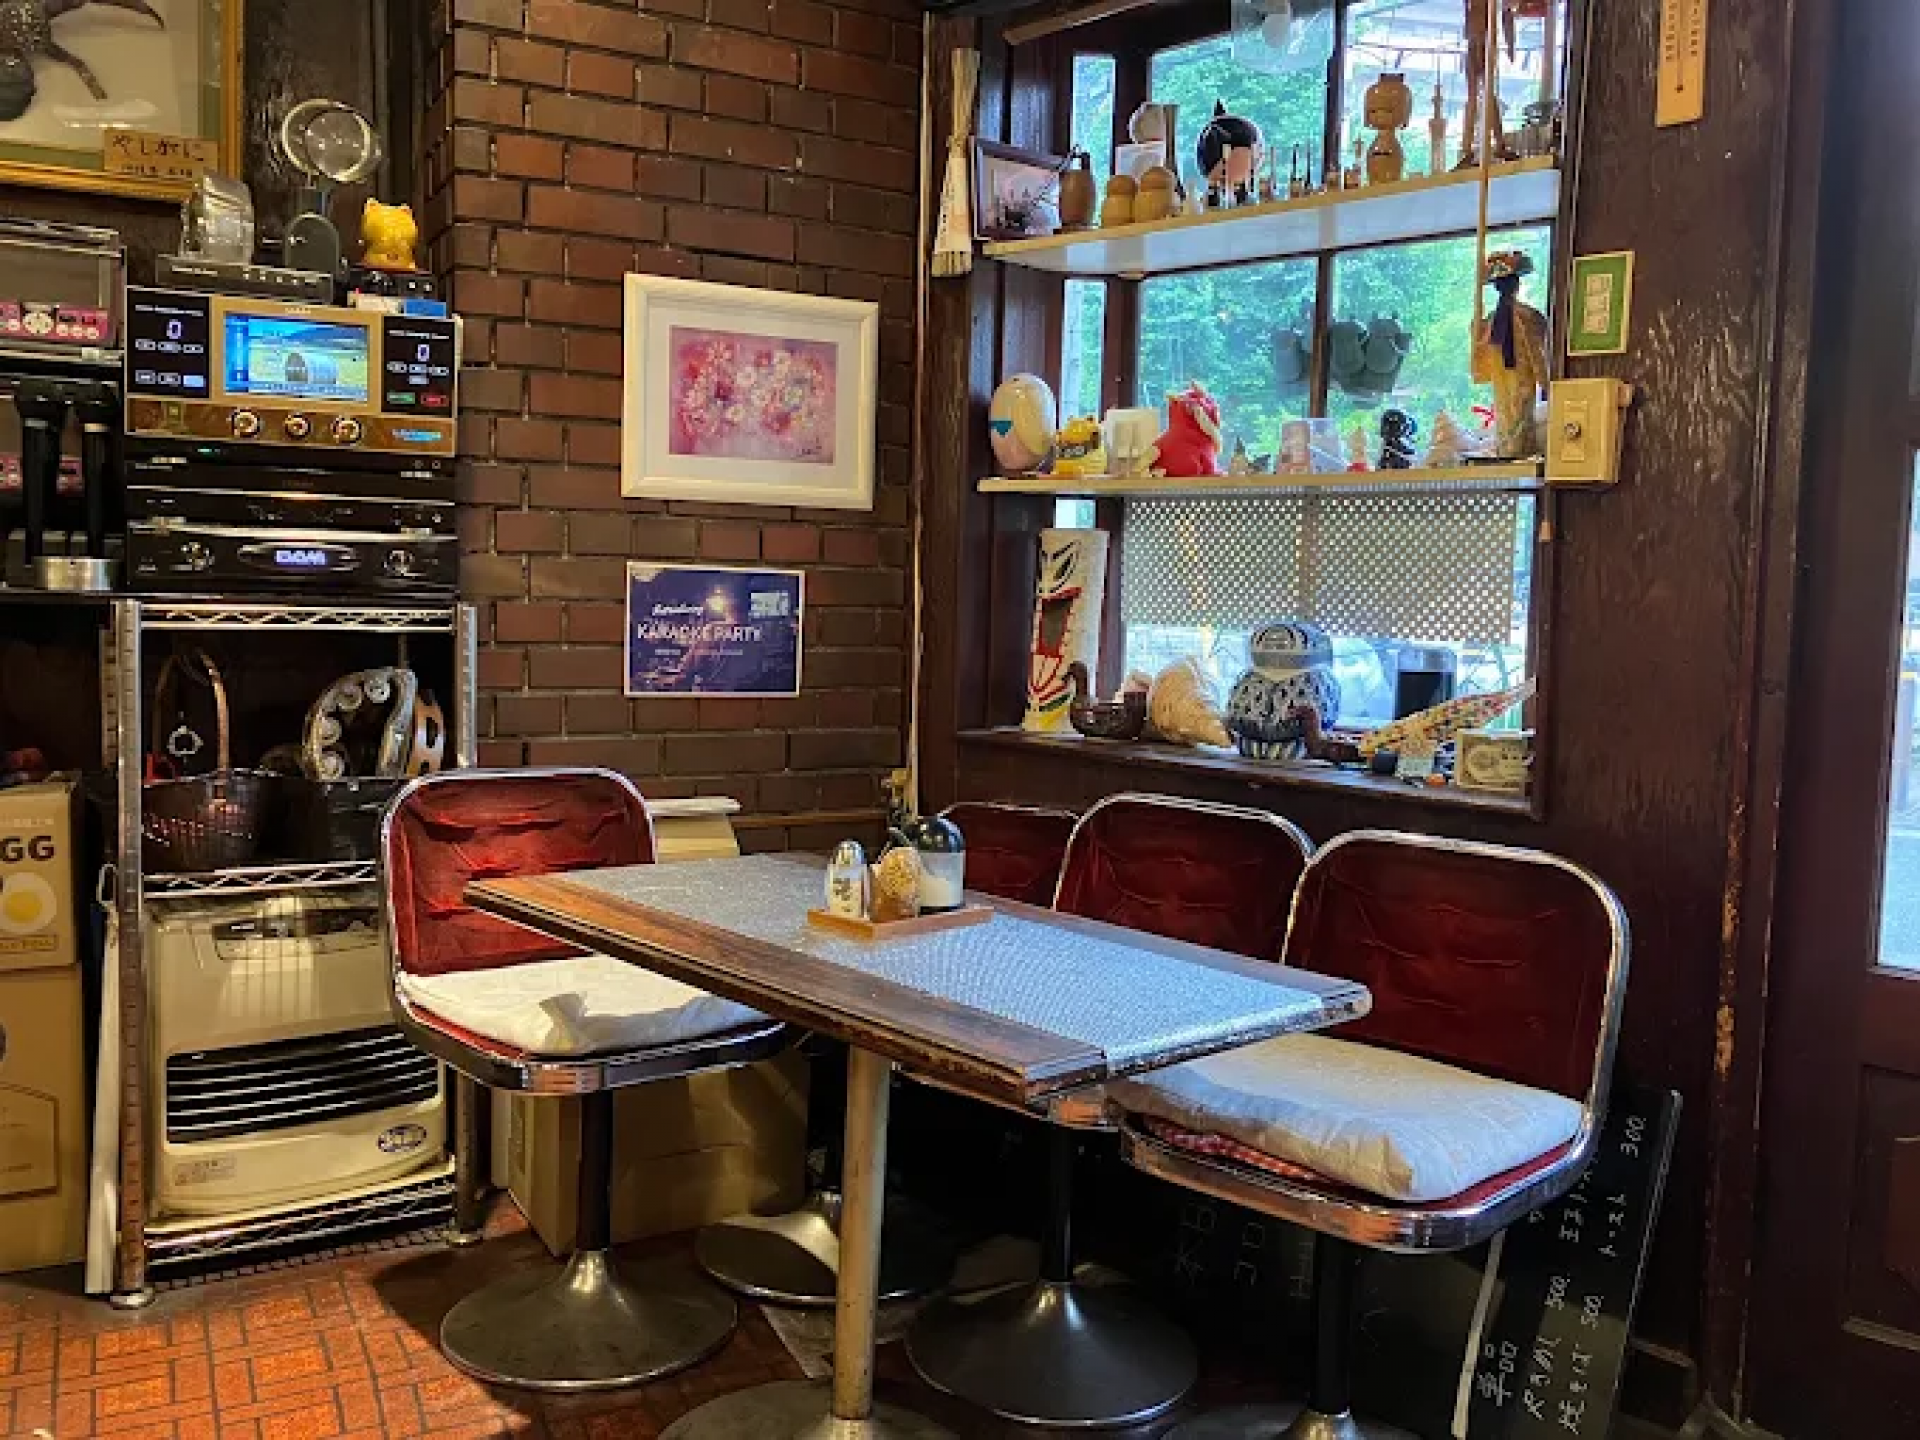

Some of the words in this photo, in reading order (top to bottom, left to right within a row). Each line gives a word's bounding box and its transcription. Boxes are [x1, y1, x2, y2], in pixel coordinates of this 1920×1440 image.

[113, 135, 205, 162] やしがに
[714, 626, 763, 642] PARTY
